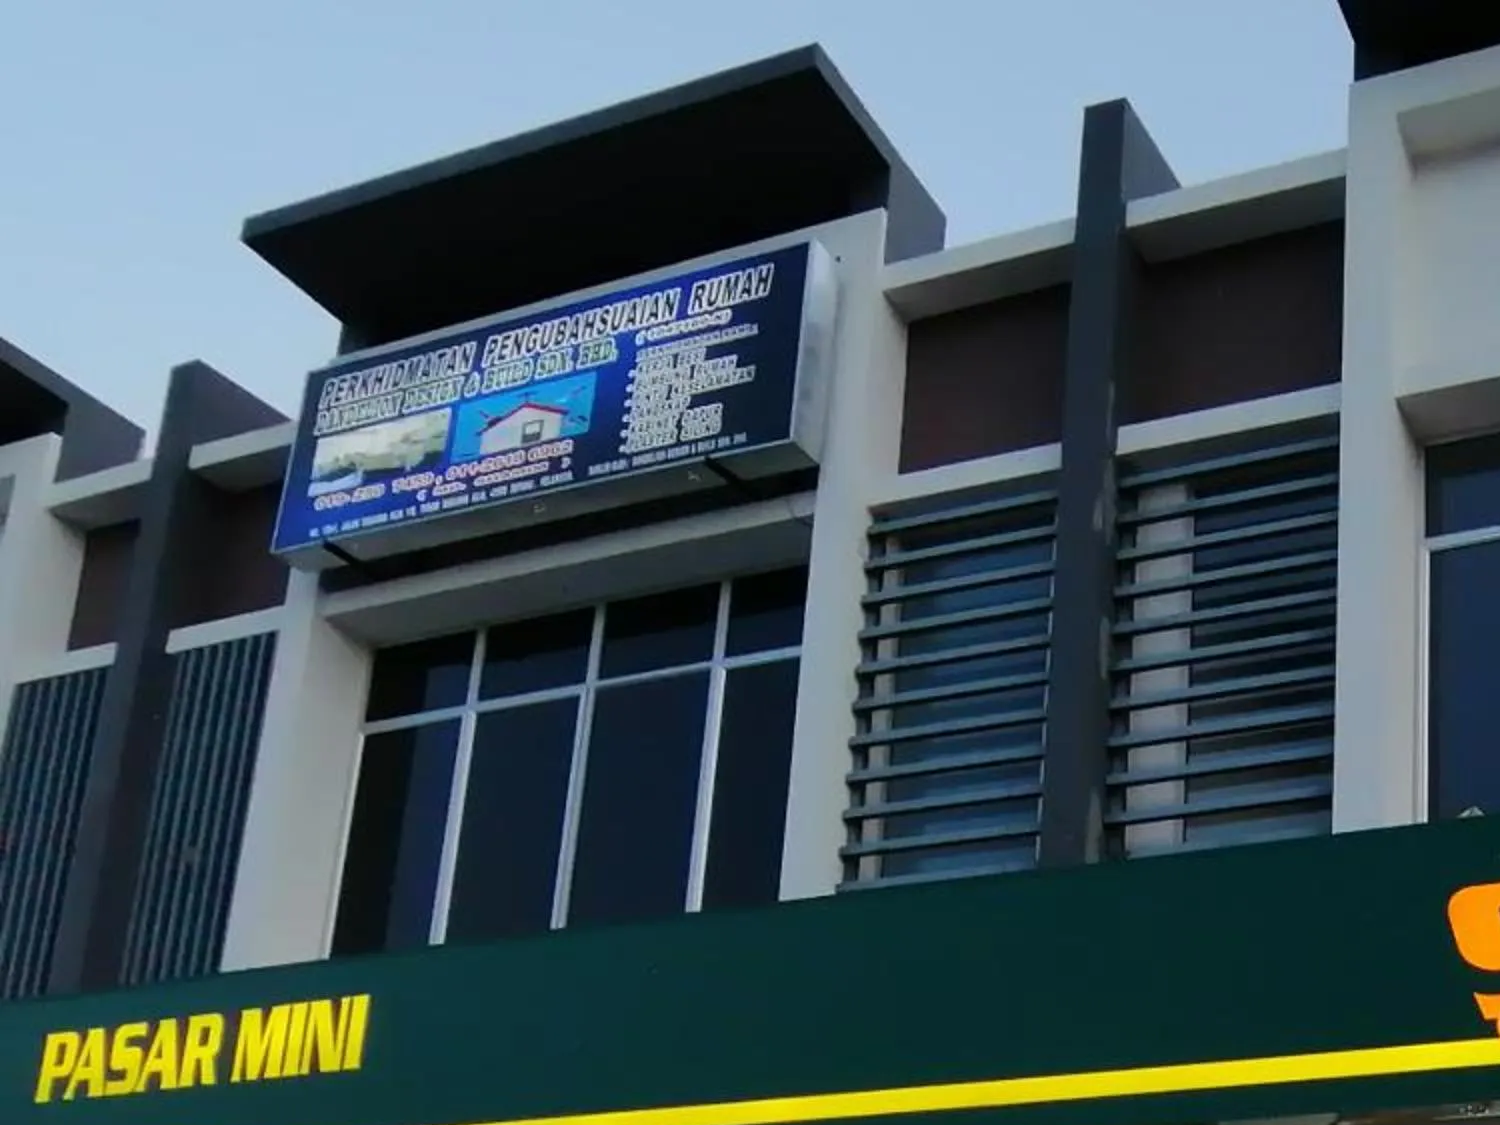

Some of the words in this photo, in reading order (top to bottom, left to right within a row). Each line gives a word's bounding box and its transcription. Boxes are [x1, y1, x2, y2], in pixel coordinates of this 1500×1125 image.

[318, 341, 477, 410] PERKHIDMATAN
[481, 287, 681, 368] PENGUBAHSUAIAN
[688, 263, 774, 316] RUMAH
[34, 1013, 225, 1104] PASAR
[230, 994, 371, 1083] MINI
